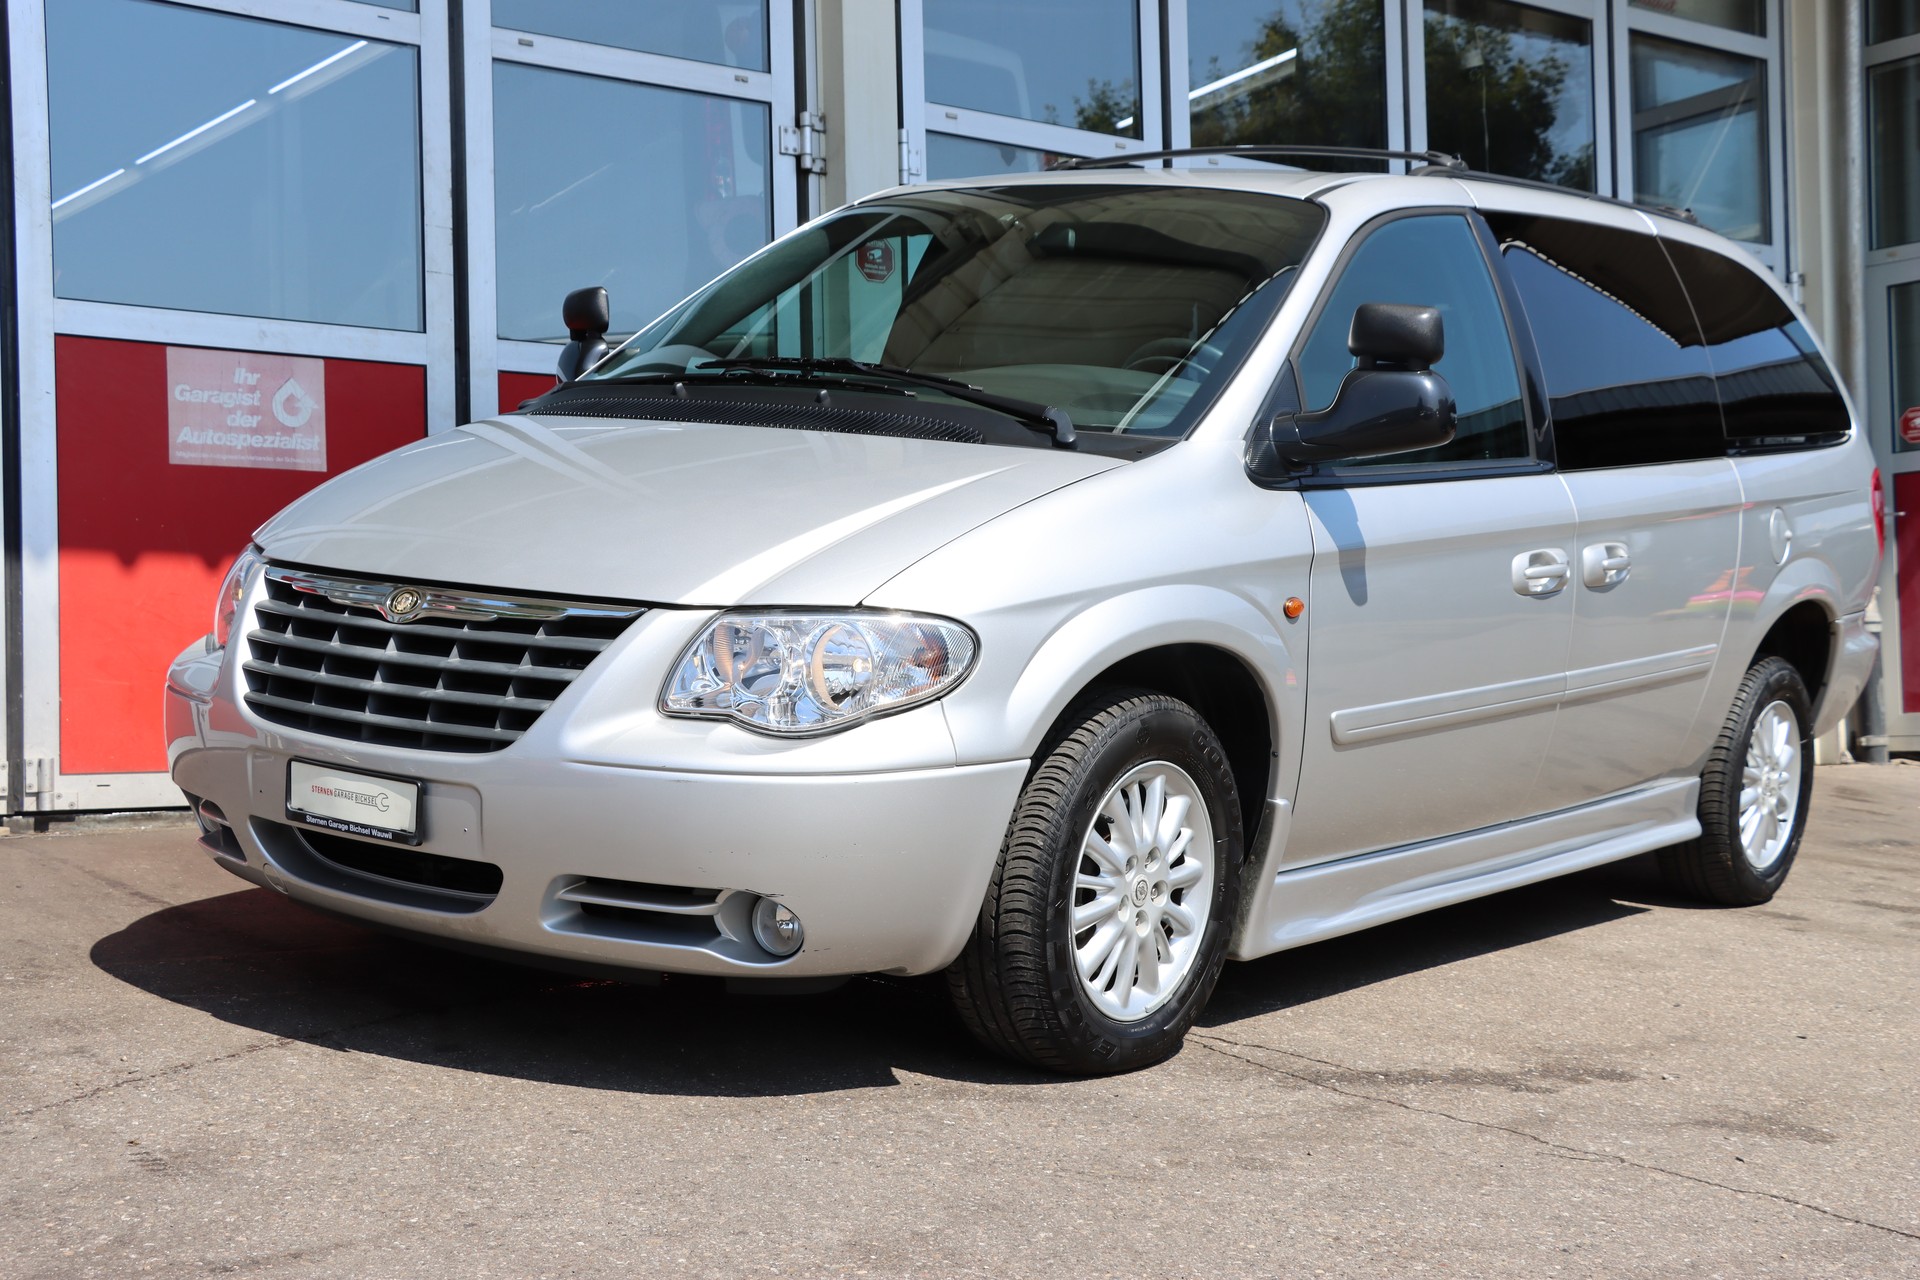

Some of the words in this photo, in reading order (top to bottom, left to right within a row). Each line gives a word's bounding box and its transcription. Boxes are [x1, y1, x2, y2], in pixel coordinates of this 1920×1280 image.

[232, 367, 261, 385] Ihr
[174, 384, 262, 408] Garagist
[226, 410, 262, 428] der
[176, 426, 321, 451] Autospezialist
[311, 785, 334, 796] STERNEN
[334, 790, 355, 801] GARAGE
[355, 795, 378, 806] BICHSEL
[305, 815, 328, 826] Sternen
[328, 819, 349, 831] Garage
[349, 825, 371, 835] Bichsel
[371, 828, 393, 840] Wauwil
